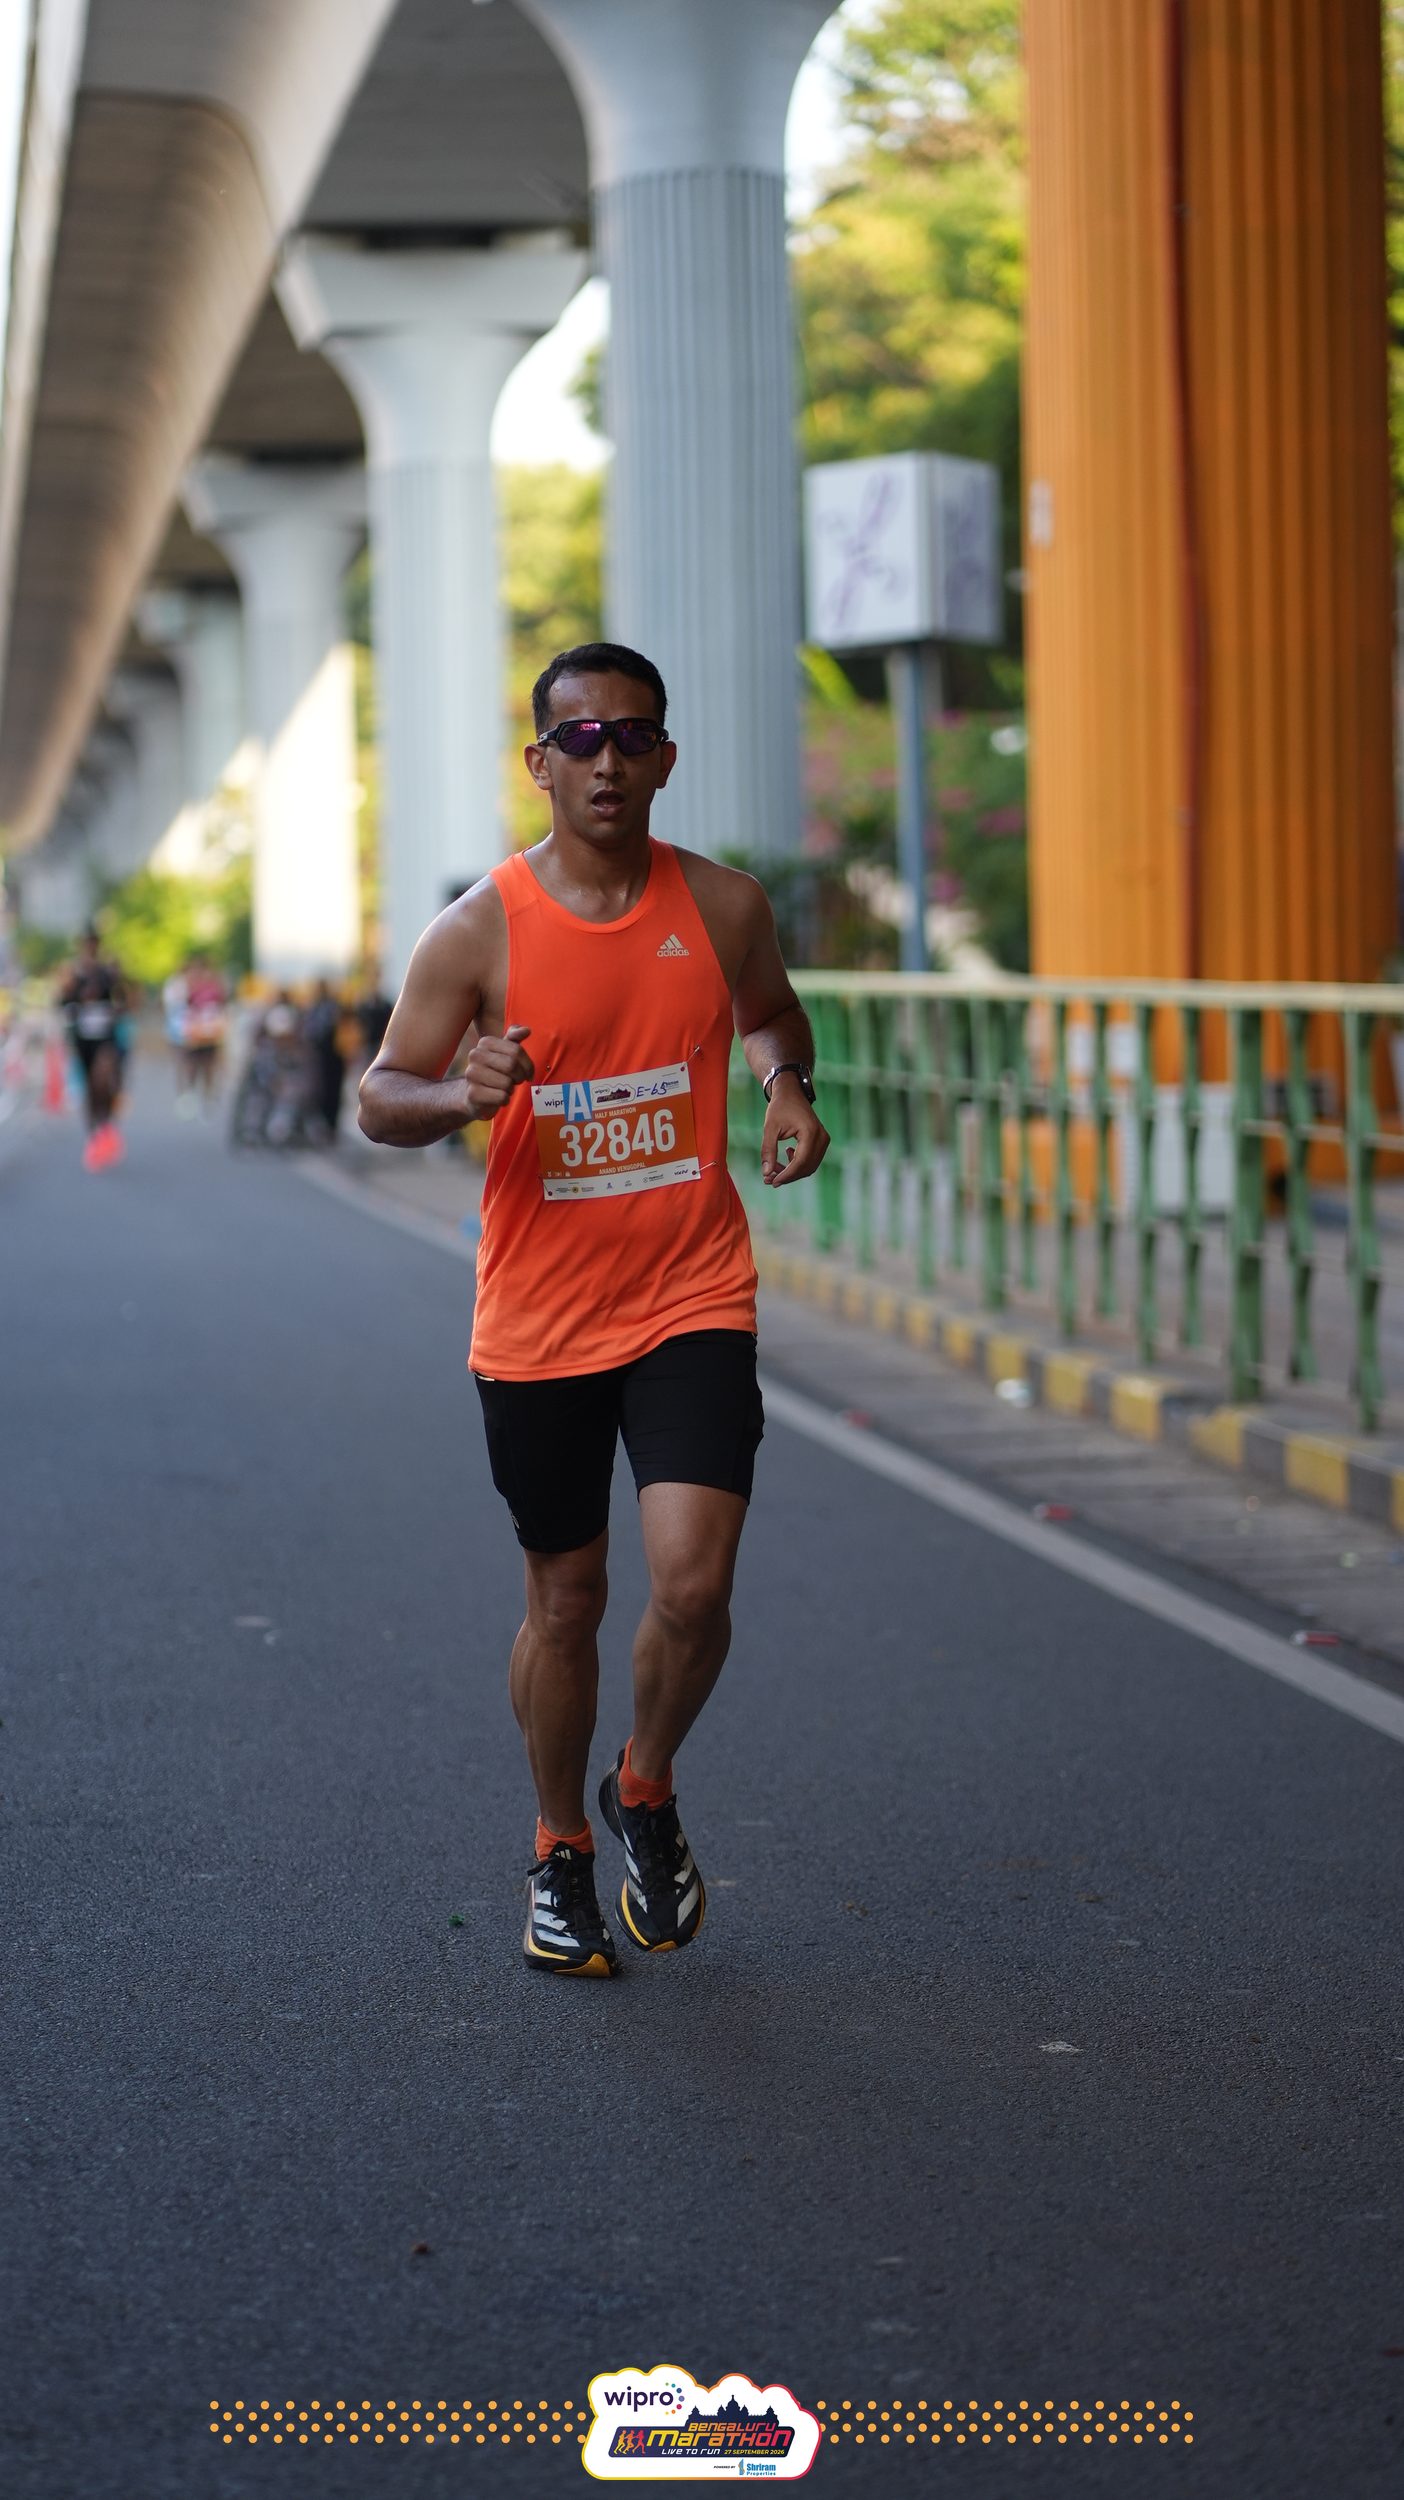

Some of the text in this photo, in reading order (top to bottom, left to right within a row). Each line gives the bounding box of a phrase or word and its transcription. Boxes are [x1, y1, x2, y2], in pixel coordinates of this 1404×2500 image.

[656, 948, 690, 958] adidas
[544, 1098, 565, 1108] wipr
[567, 1082, 593, 1122] A
[594, 1106, 637, 1119] HALF MARATHON
[558, 1108, 676, 1168] 32846
[598, 1166, 617, 1175] ANAND
